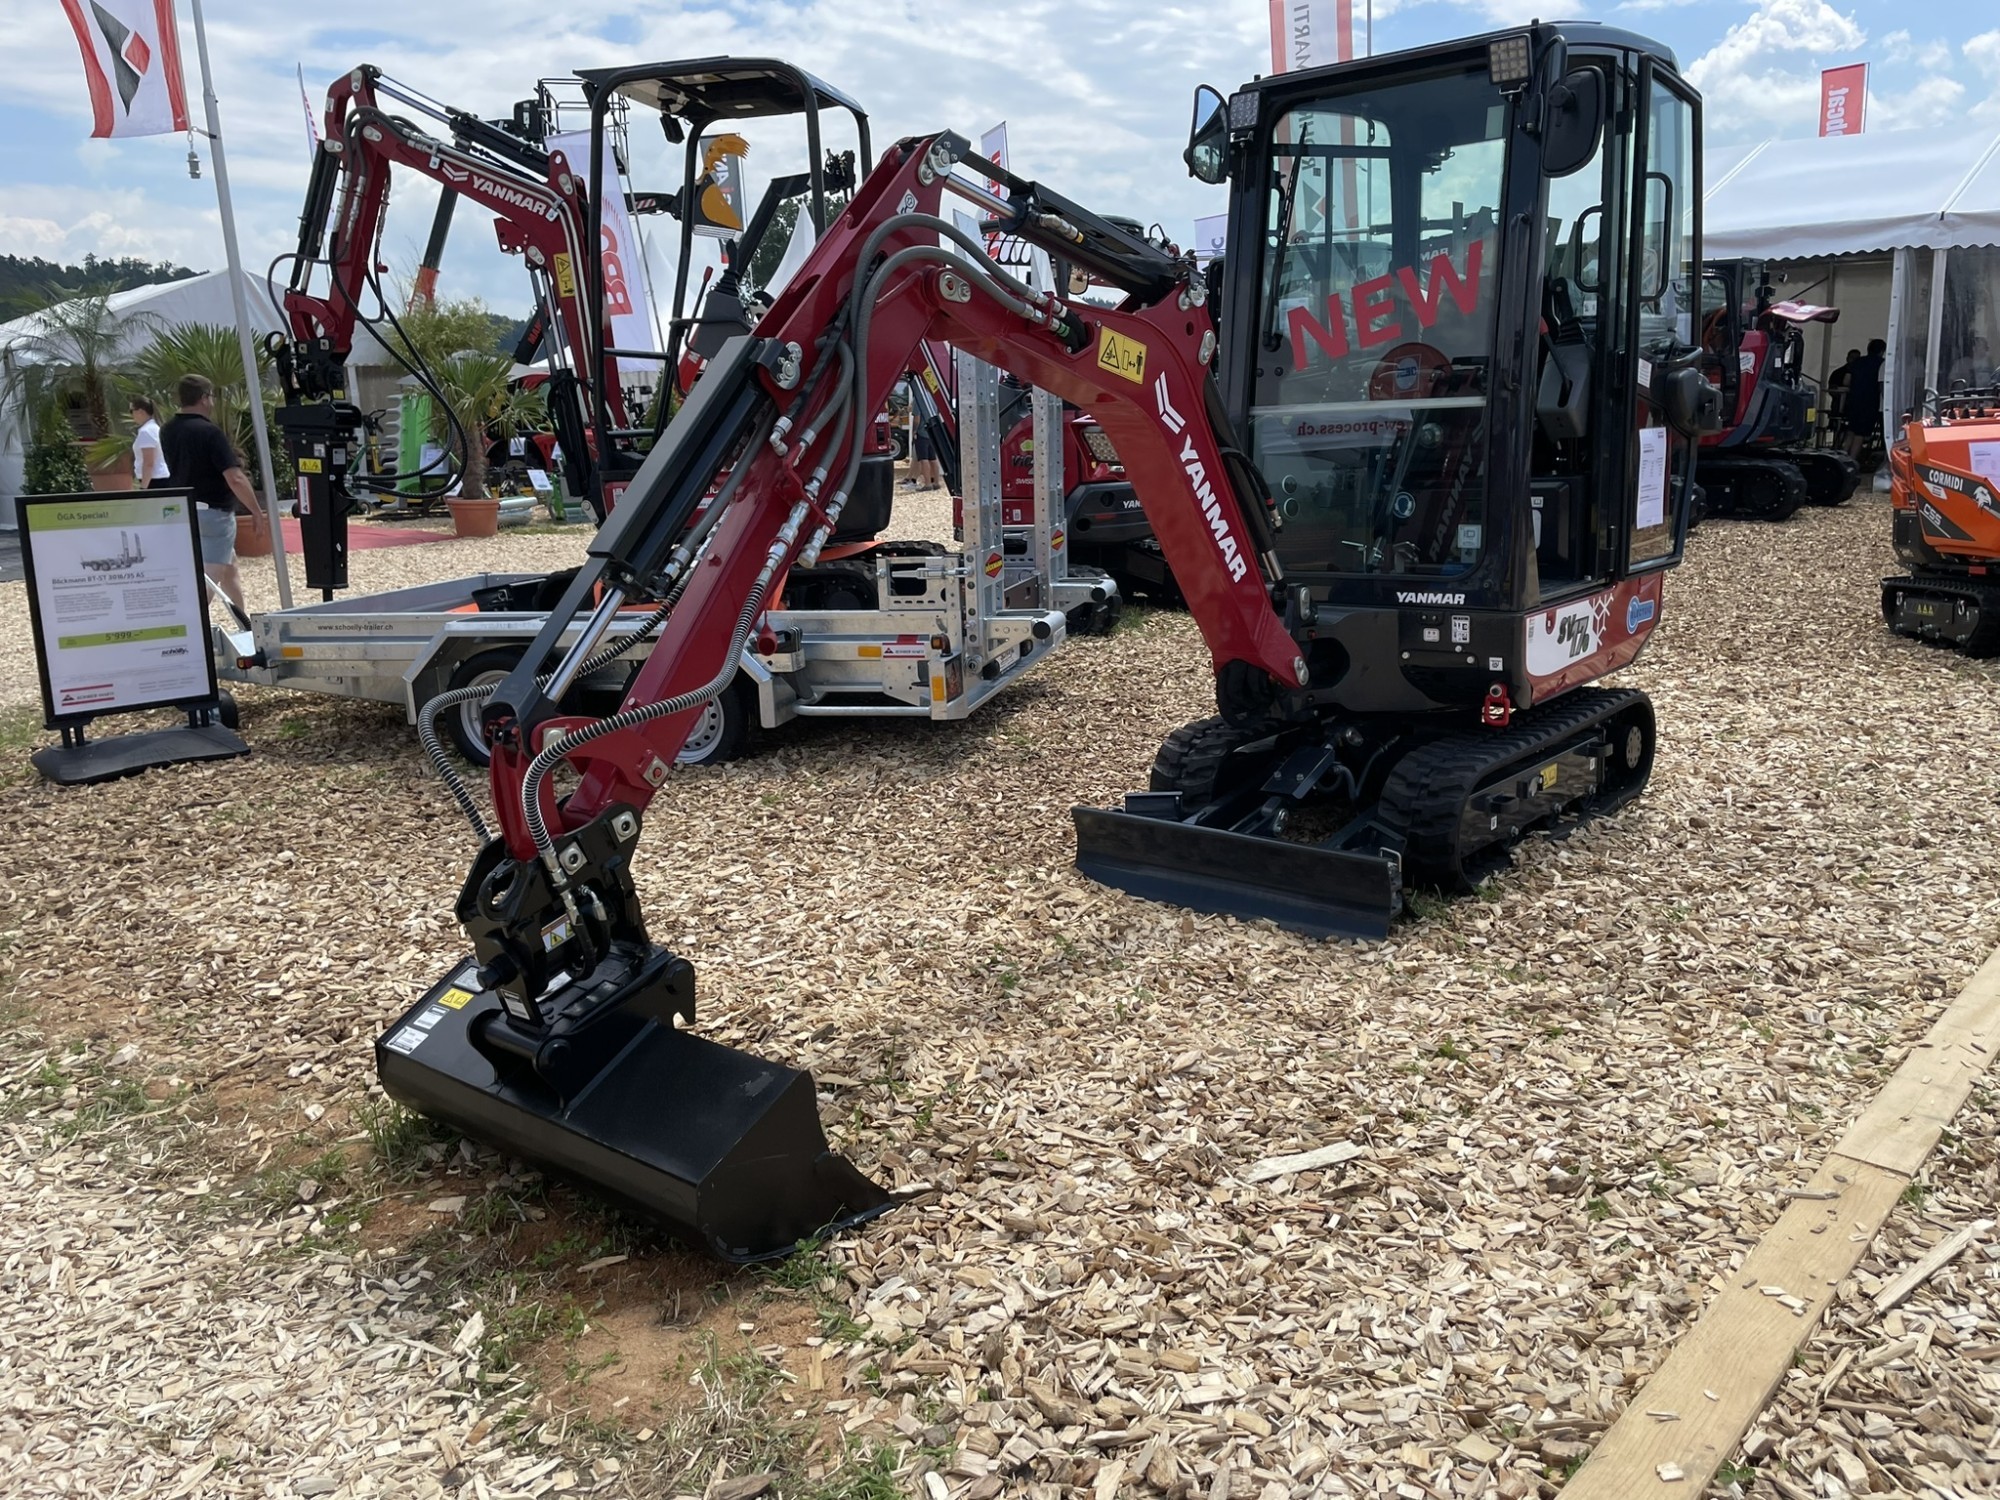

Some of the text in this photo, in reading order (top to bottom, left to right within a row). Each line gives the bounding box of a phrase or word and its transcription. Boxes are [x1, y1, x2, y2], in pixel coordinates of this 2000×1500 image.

[472, 175, 548, 216] YANMAR
[1287, 239, 1483, 372] NEW
[1928, 469, 1964, 492] CORMIDI
[1122, 499, 1144, 510] YAN
[1179, 433, 1247, 584] YANMAR
[1396, 592, 1466, 605] YANMAR
[318, 623, 394, 632] www.schoelly-trailer.ch
